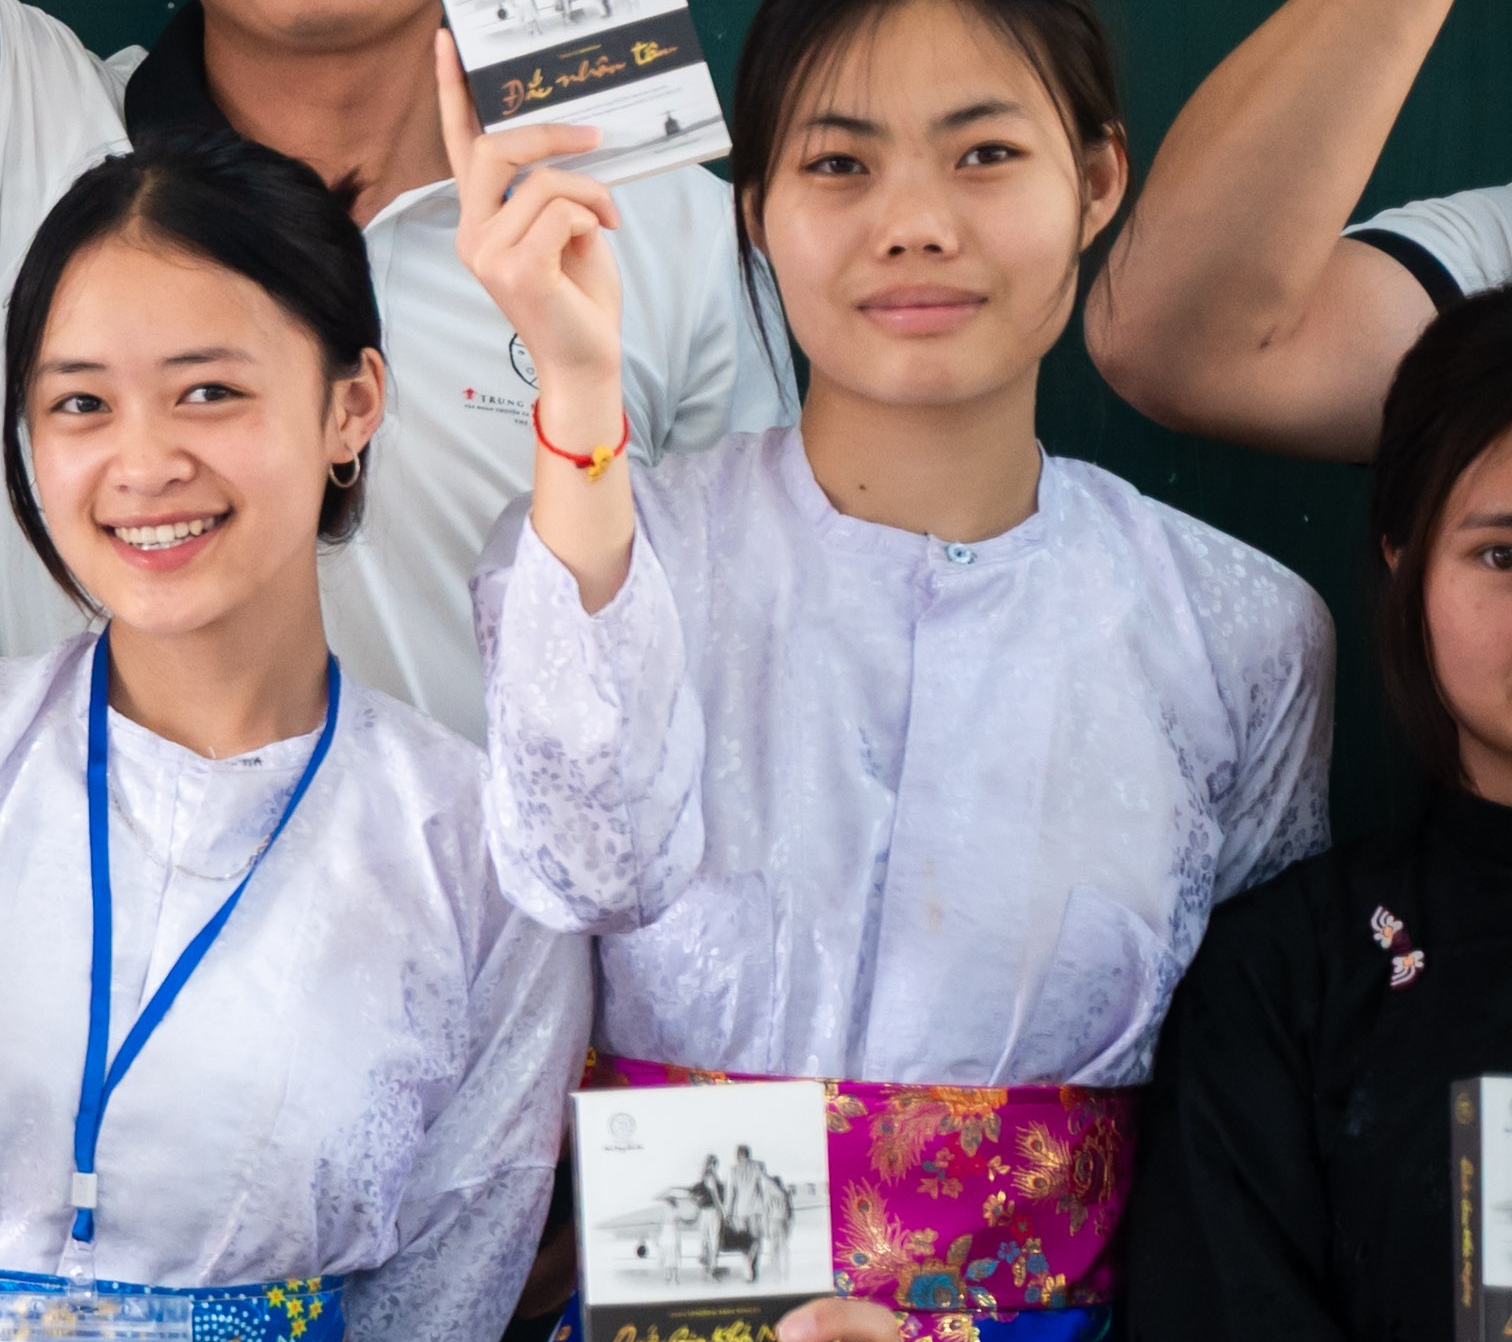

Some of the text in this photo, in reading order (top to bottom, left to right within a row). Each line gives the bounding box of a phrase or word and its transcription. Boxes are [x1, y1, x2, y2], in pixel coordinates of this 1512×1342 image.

[501, 68, 554, 116] Đắc
[555, 55, 627, 88] nhân
[481, 395, 524, 408] TRUNG
